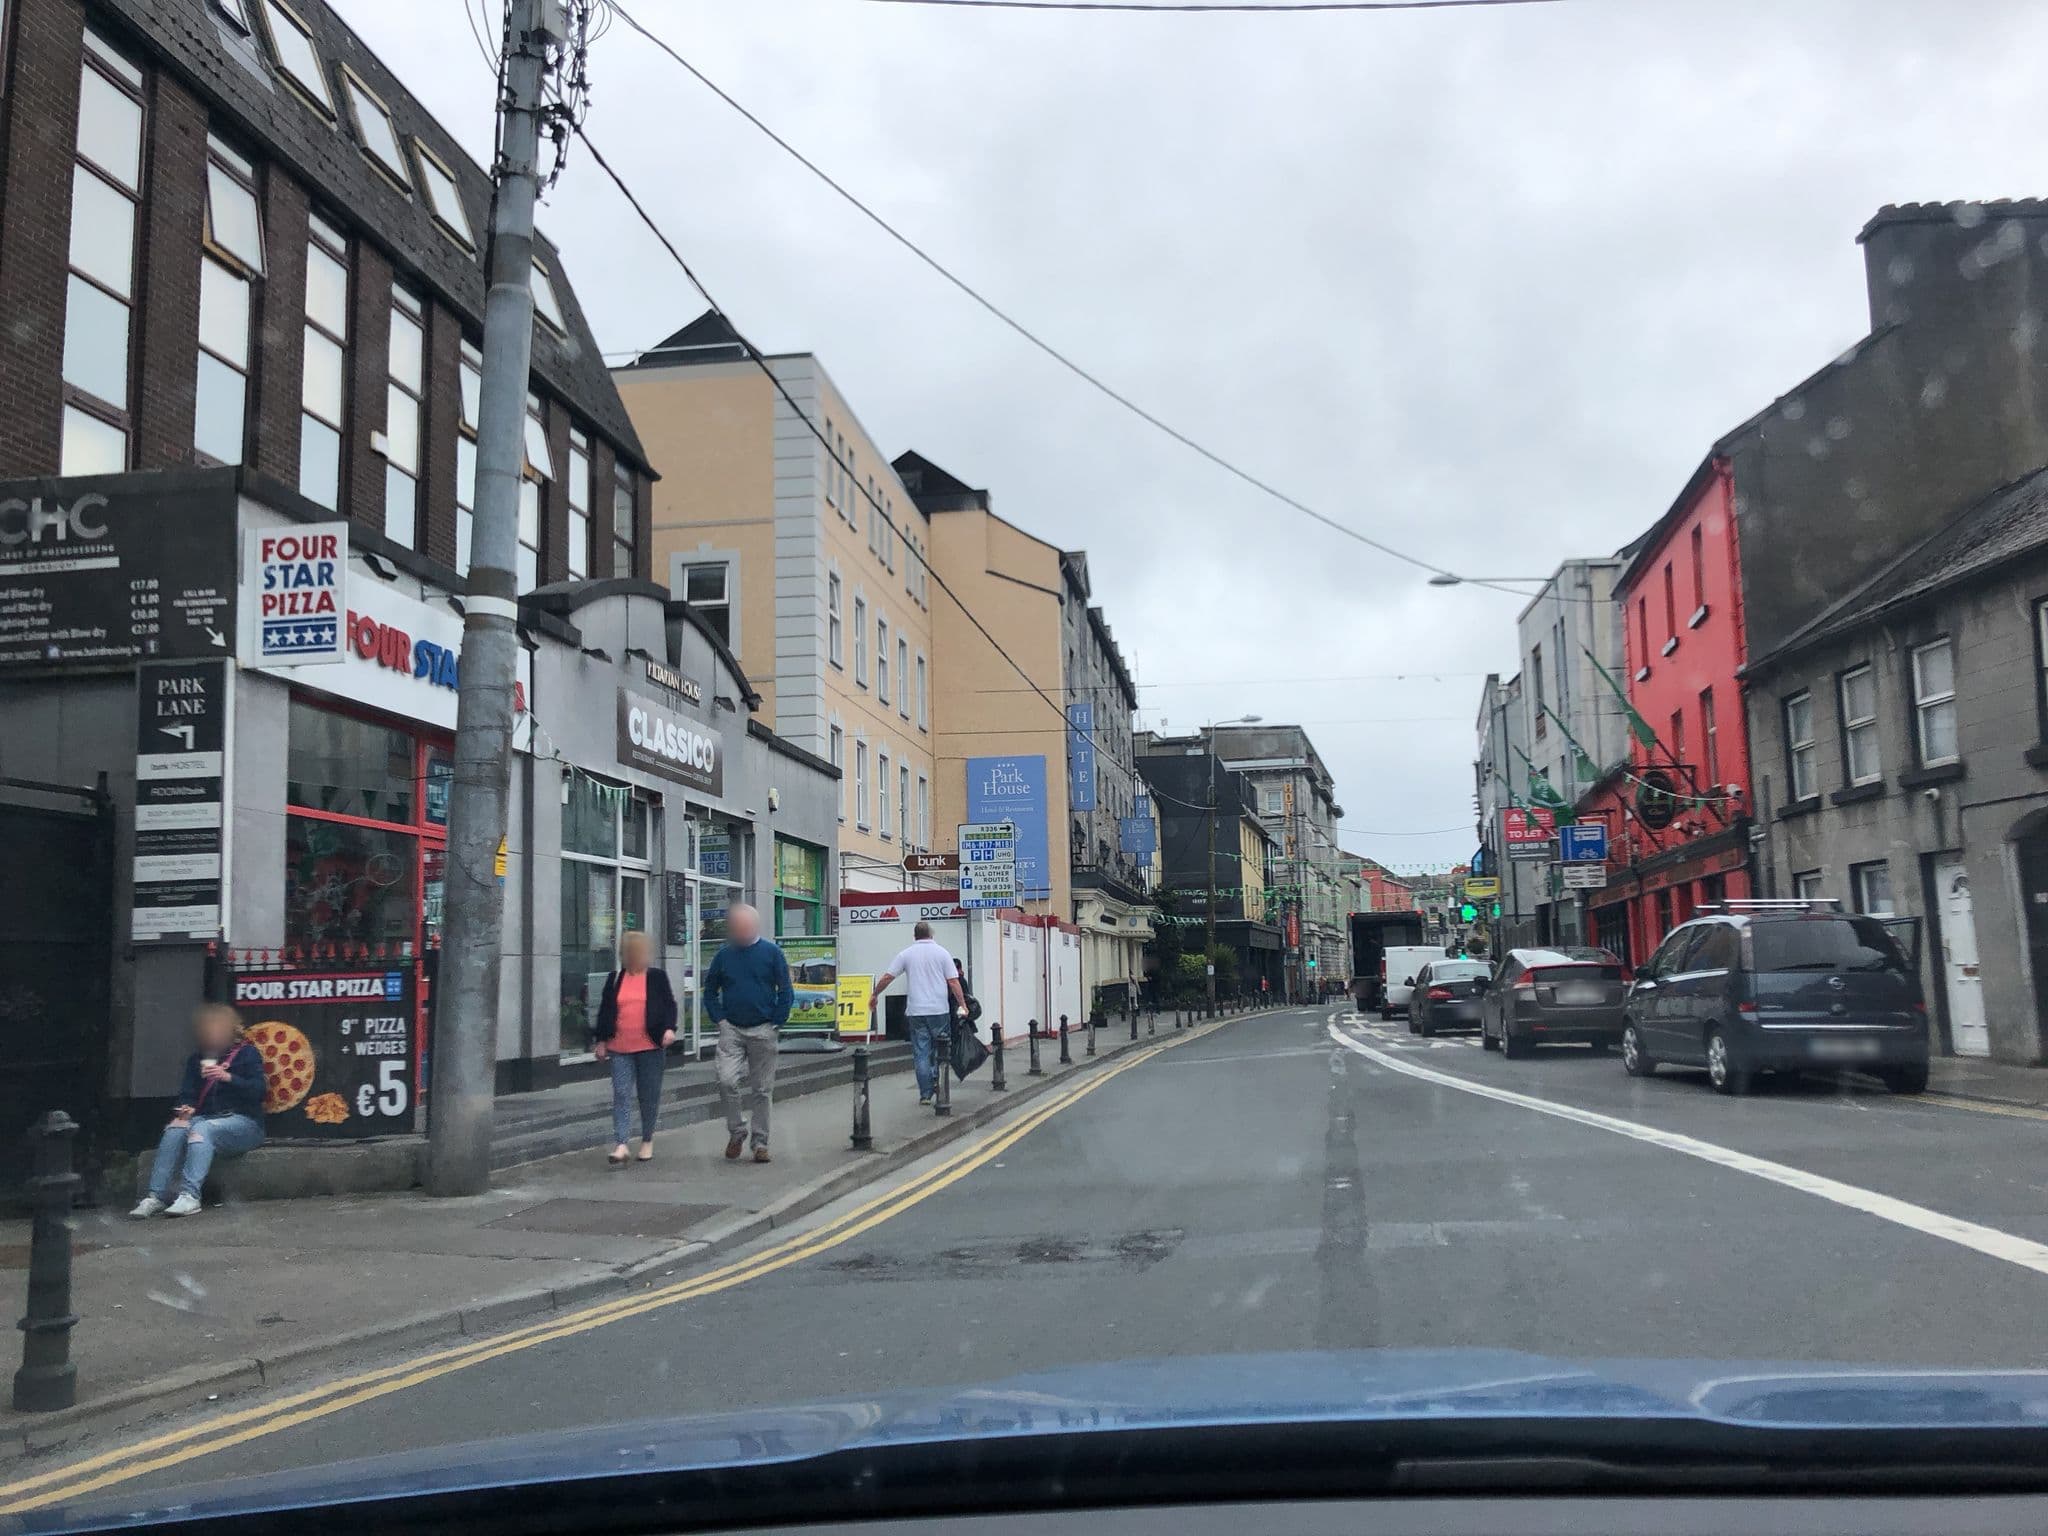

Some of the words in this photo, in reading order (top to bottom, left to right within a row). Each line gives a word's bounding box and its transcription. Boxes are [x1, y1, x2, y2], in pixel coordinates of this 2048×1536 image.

[0, 493, 109, 545] CHC
[262, 535, 338, 562] FOUR
[263, 561, 334, 589] STAR
[262, 588, 335, 617] PIZZA
[347, 609, 412, 676] FOUR
[413, 640, 460, 690] STA
[159, 678, 206, 696] PARK
[157, 698, 206, 717] LANE
[628, 706, 715, 773] CLASSICO
[1076, 711, 1089, 803] HOTEL
[991, 768, 1024, 783] Park
[983, 781, 1031, 796] House
[1507, 830, 1523, 838] TO
[1524, 829, 1543, 838] LET
[918, 856, 946, 867] bunk
[850, 909, 878, 920] DOC
[920, 906, 949, 917] DOC
[236, 981, 284, 1001] FOUR
[288, 980, 335, 999] STAR
[335, 978, 385, 998] PIZZA
[838, 1002, 854, 1016] 11
[364, 1017, 405, 1034] PIZZA
[355, 1040, 407, 1056] WEDGES
[357, 1060, 408, 1116] €5
